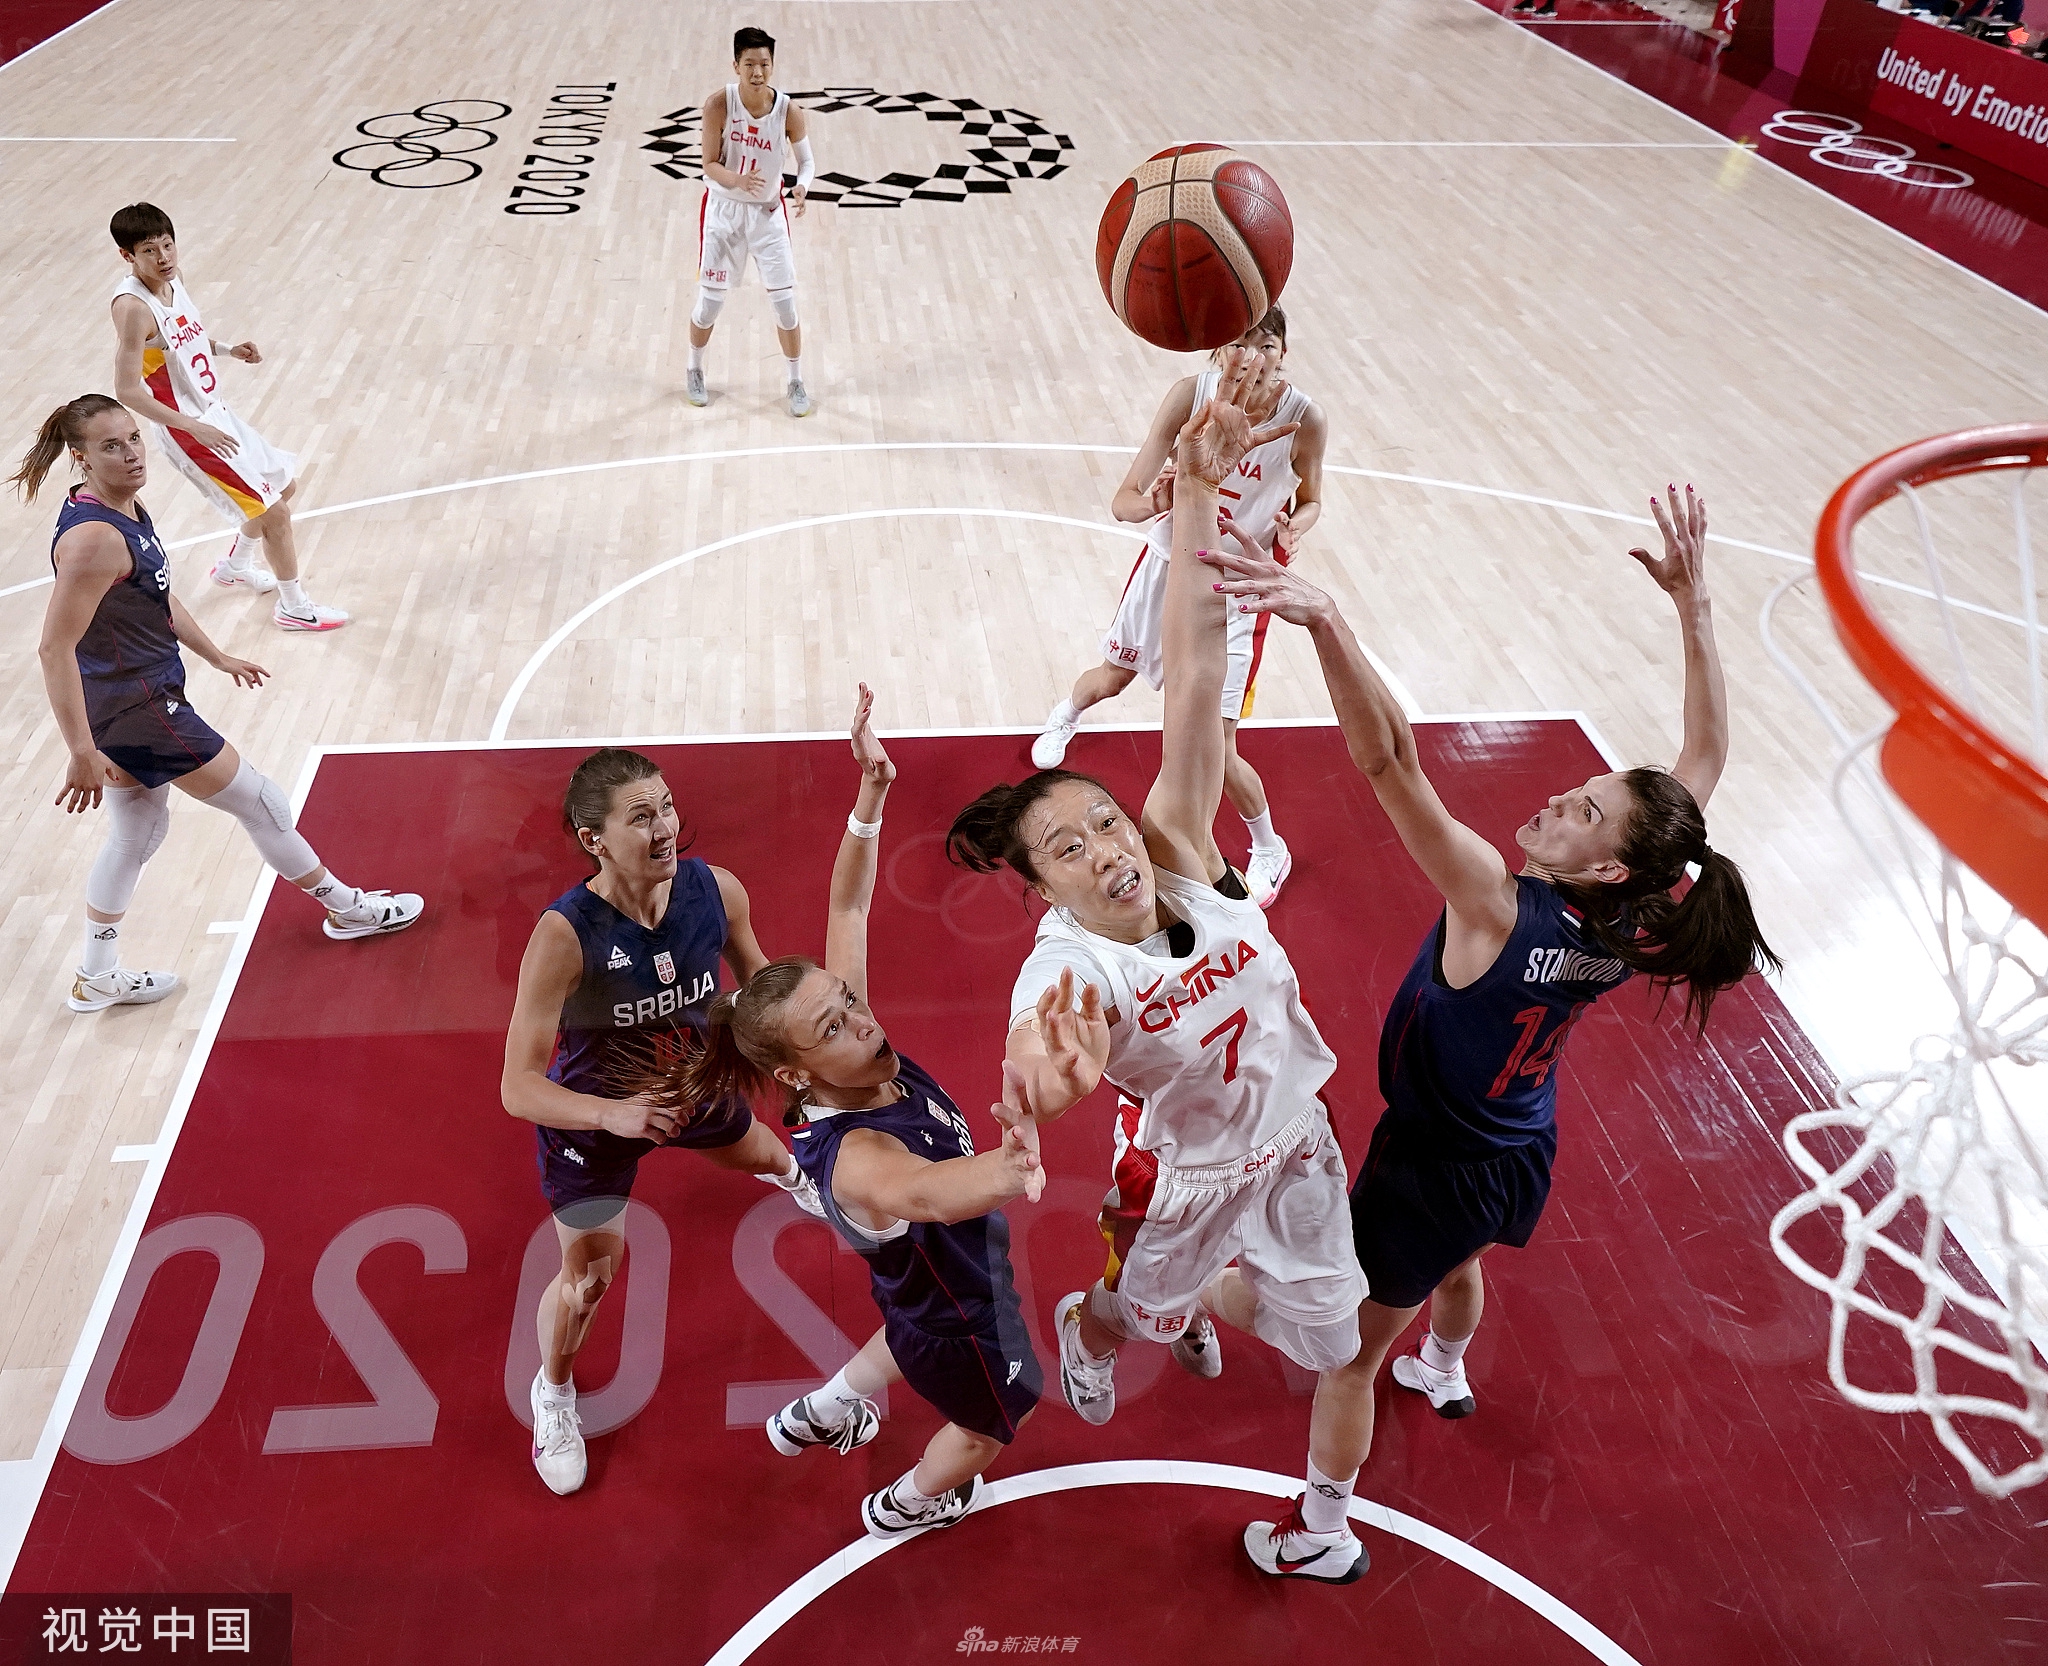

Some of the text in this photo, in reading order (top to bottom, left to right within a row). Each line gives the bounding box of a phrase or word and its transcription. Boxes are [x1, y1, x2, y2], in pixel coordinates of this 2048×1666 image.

[1876, 46, 1947, 100] United
[1941, 73, 1974, 117] by
[1970, 84, 2048, 147] Emotio
[504, 82, 617, 215] TOKYO 2020
[730, 131, 772, 151] CHINA
[191, 352, 216, 394] 3
[607, 955, 633, 971] PEAK
[1137, 939, 1259, 1034] CHINA
[613, 970, 715, 1027] SRBIJA
[1199, 1006, 1249, 1085] 7
[1487, 1000, 1588, 1098] 14
[1243, 1148, 1276, 1173] CHN
